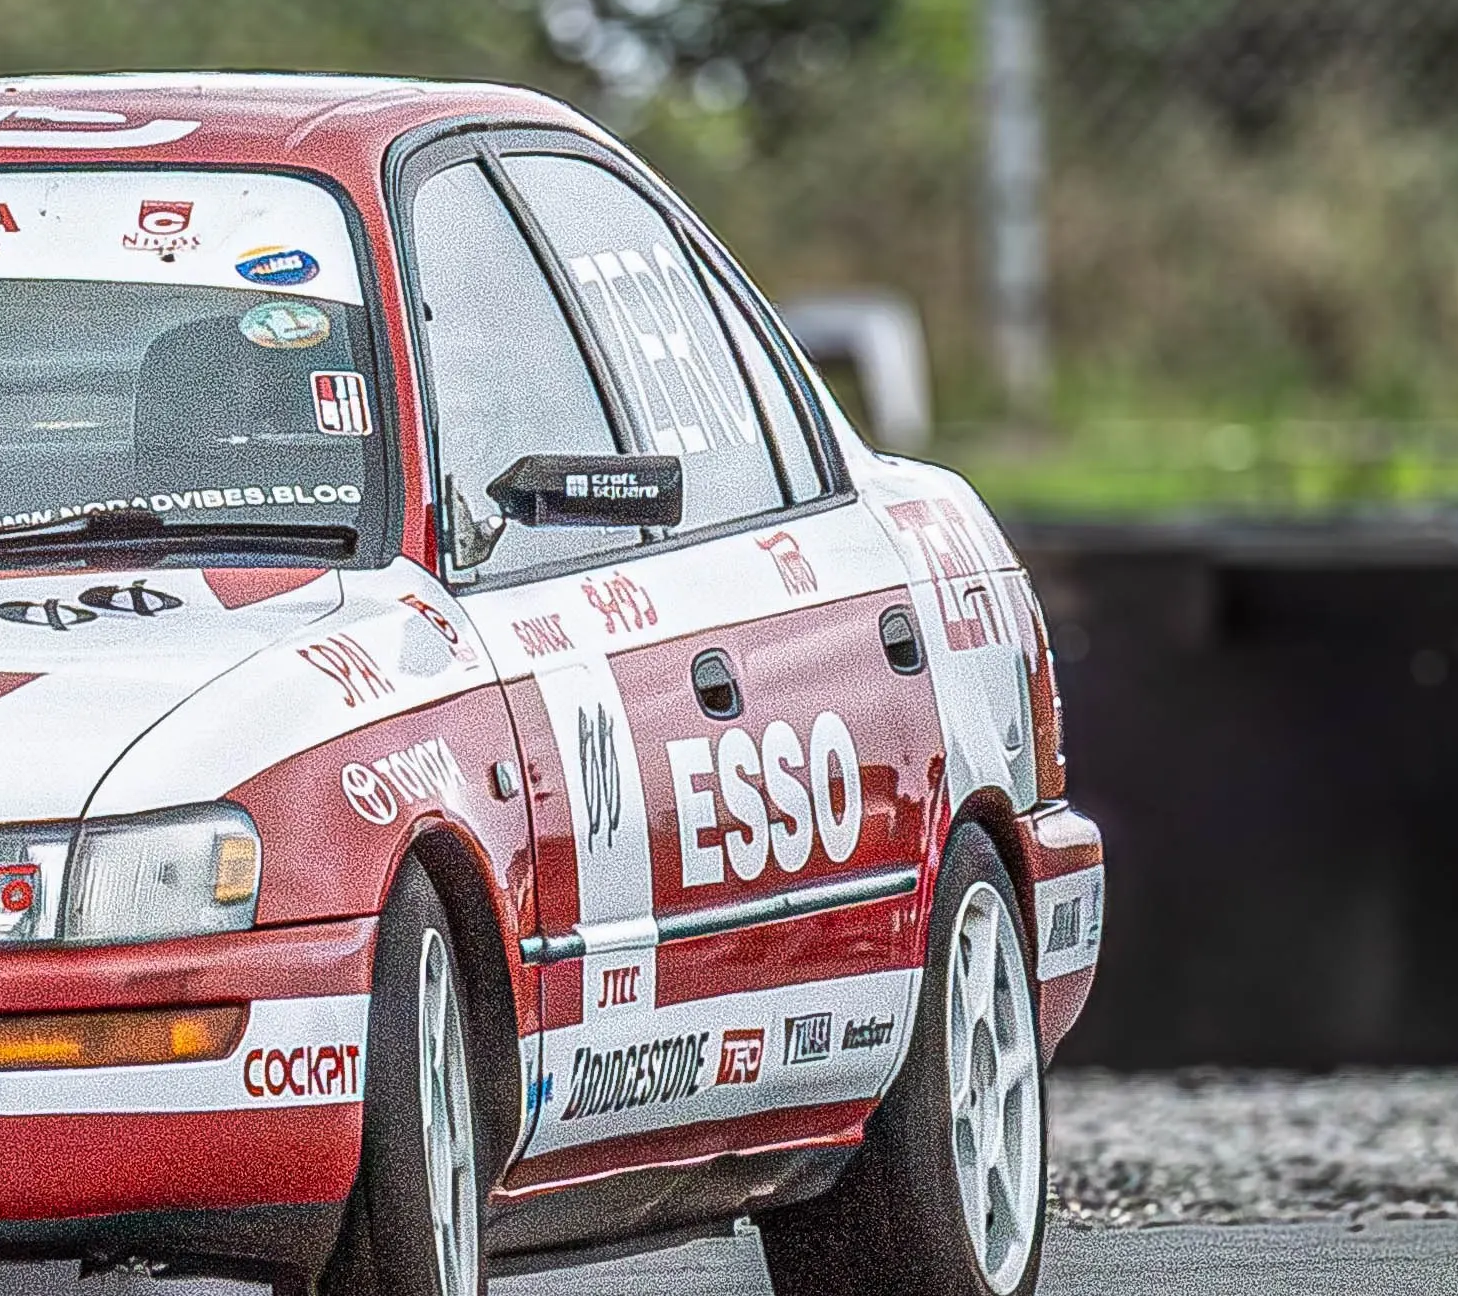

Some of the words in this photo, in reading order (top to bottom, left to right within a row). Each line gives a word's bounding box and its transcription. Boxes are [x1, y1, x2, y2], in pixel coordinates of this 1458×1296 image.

[372, 736, 467, 804] TOYOTA
[666, 710, 862, 889] ESSO
[244, 1043, 360, 1098] COCKPIT
[560, 1031, 710, 1122] BRIDGESTONE
